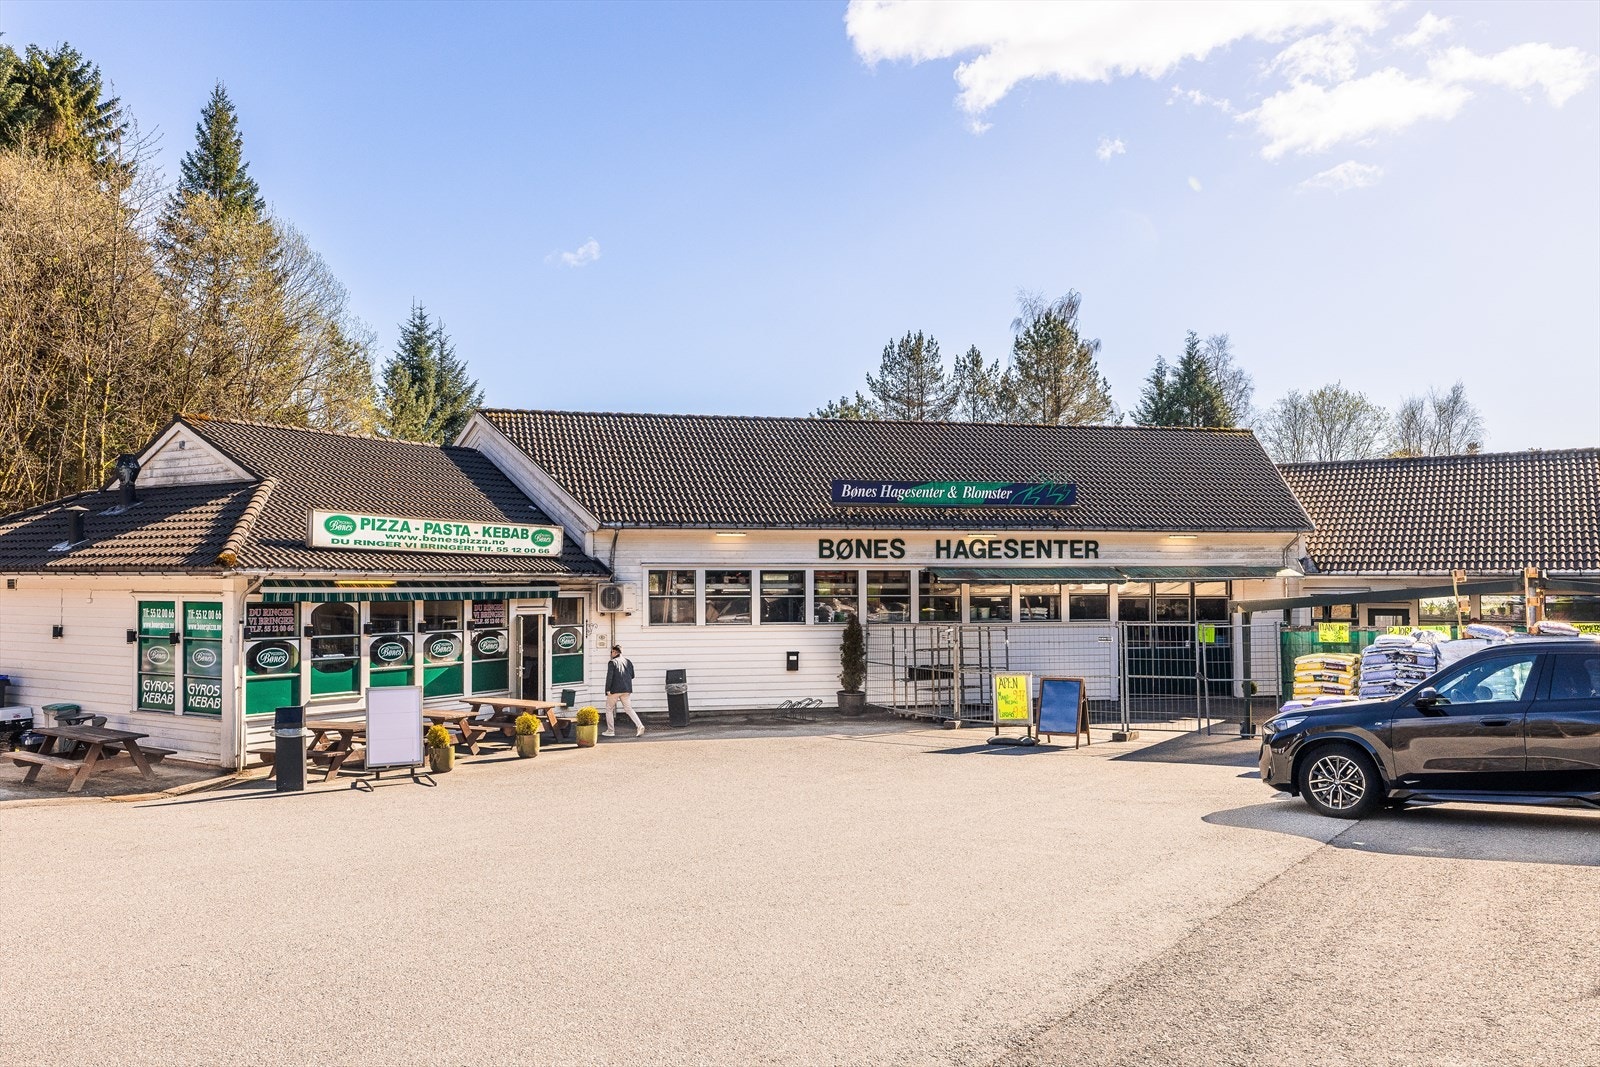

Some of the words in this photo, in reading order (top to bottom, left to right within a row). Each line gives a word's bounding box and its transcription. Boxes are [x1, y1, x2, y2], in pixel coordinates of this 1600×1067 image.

[841, 484, 877, 498] Bønes
[880, 485, 945, 501] Hagesenter
[948, 486, 957, 498] &
[962, 486, 1012, 499] Blomster
[360, 517, 411, 533] PIZZA
[424, 522, 471, 536] PASTA
[482, 526, 529, 540] KEBAB
[354, 539, 402, 548] RINGER
[420, 543, 474, 552] BRINGER!
[385, 533, 505, 546] www.bonespizza.no
[818, 538, 906, 560] BØNES
[935, 539, 1100, 560] HAGESENTER
[150, 608, 156, 618] 55
[156, 608, 162, 618] 12
[162, 609, 168, 618] 00
[168, 609, 174, 618] 66
[196, 610, 202, 620] 55
[202, 610, 208, 620] 12
[208, 610, 214, 620] 00
[215, 610, 222, 620] 66
[248, 608, 262, 616] DU
[262, 608, 294, 616] RINGER
[248, 617, 258, 626] VI
[258, 616, 294, 625] BRINGER
[143, 680, 174, 693] GYROS
[188, 683, 220, 697] GYROS
[142, 692, 174, 705] KEBAB
[188, 696, 222, 709] KEBAB
